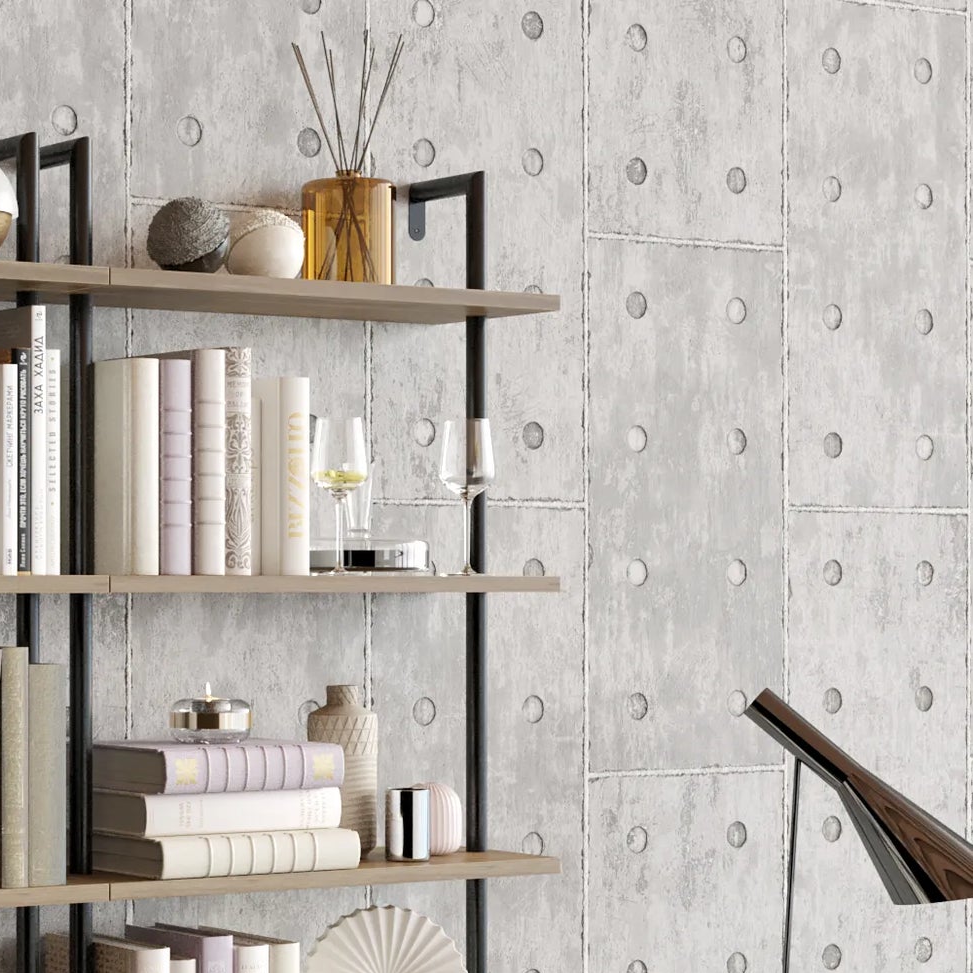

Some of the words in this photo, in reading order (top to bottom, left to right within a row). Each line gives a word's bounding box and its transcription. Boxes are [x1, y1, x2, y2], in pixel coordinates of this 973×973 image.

[33, 336, 44, 377] ХАДИД
[5, 385, 14, 430] МАРКЕРАМИ
[33, 384, 44, 414] ЗАХА
[48, 369, 57, 422] STORIES
[48, 432, 57, 493] SELECTED
